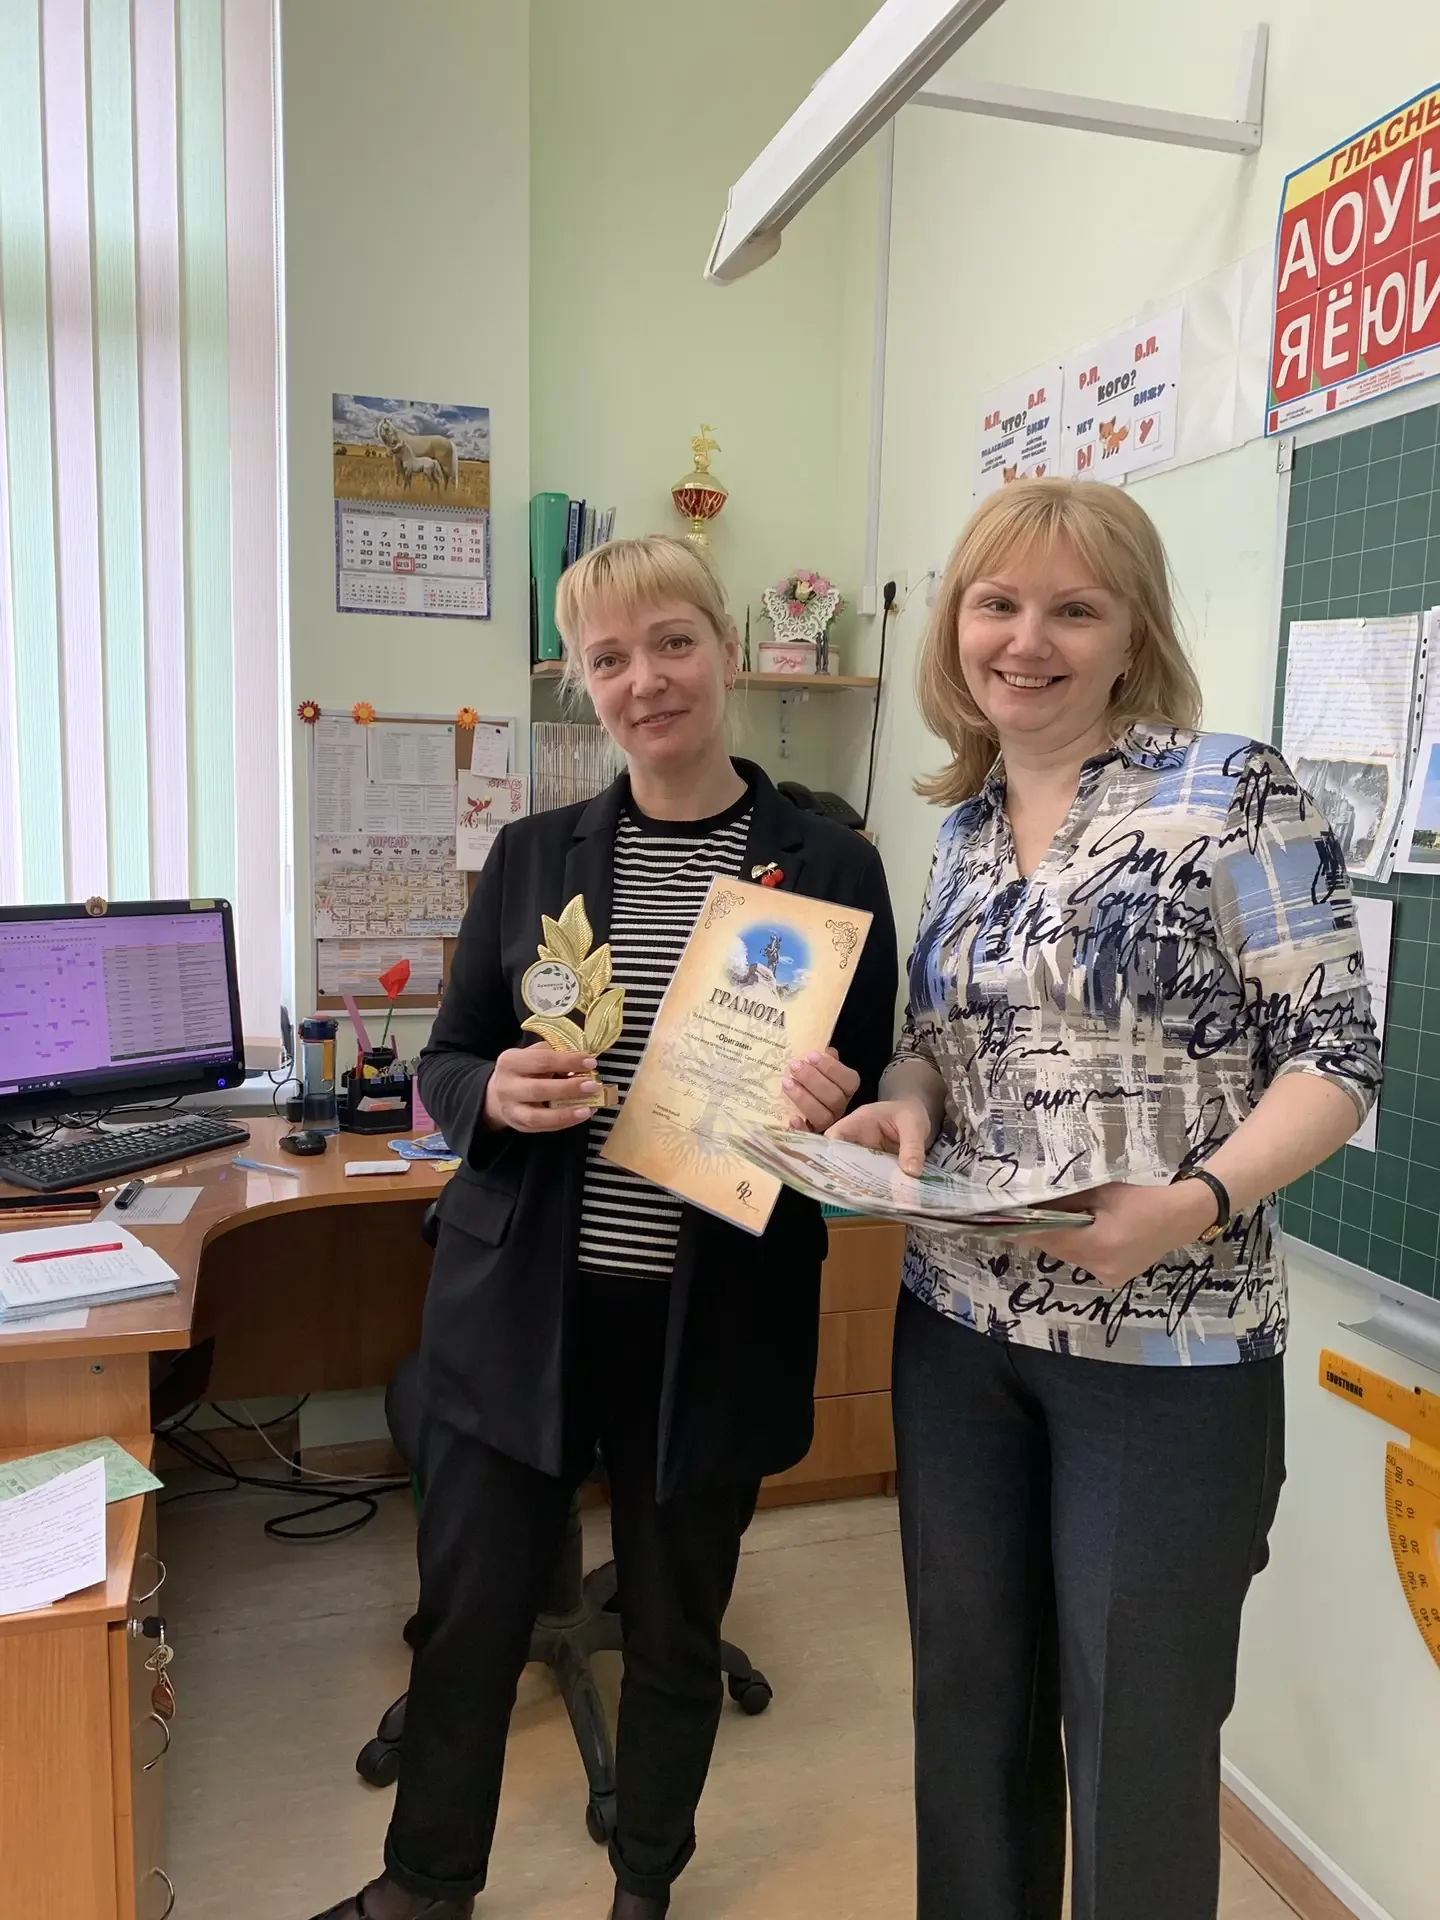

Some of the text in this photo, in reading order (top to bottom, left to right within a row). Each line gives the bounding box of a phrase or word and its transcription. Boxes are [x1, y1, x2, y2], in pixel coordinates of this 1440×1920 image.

[1097, 369, 1137, 402] КОГО?
[1133, 383, 1165, 407] ВИЖУ
[1001, 410, 1027, 433] ЧТО?
[1076, 418, 1094, 436] НЕТ
[709, 987, 785, 1027] ГРАМОТА
[1395, 1466, 1403, 1484] 180
